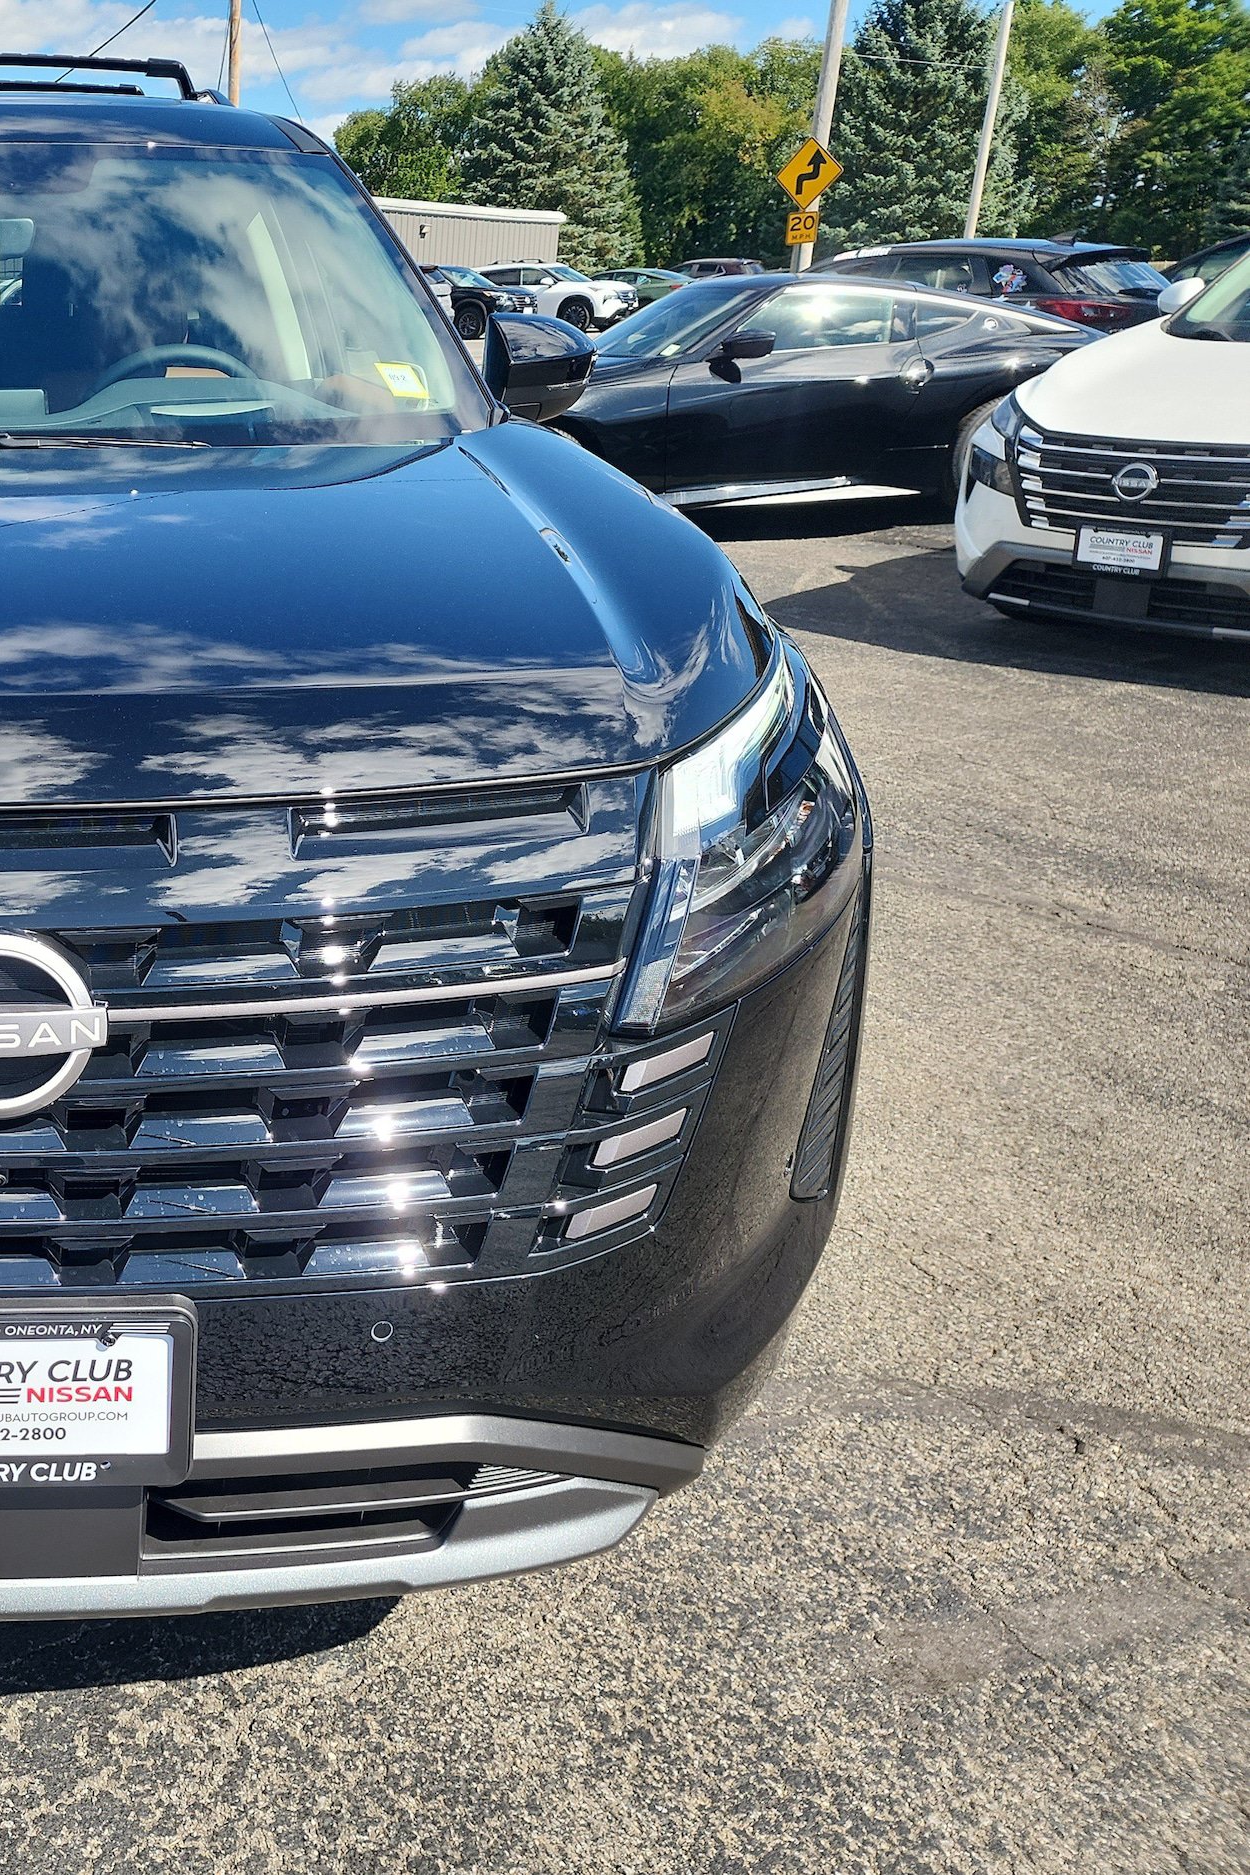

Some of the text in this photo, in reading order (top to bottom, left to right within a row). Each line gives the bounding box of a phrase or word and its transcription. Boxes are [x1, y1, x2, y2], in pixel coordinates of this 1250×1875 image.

[790, 215, 815, 231] 20
[1111, 476, 1159, 489] NISSAN
[1089, 535, 1154, 549] COUNTRY CLUB
[1126, 547, 1153, 555] NISSAN
[1092, 564, 1140, 576] COUNTRY CLUB
[4, 1325, 79, 1336] ONEONTA,
[47, 1359, 133, 1382] CLUB
[26, 1386, 133, 1403] NISSAN
[29, 1462, 97, 1482] CLUB
